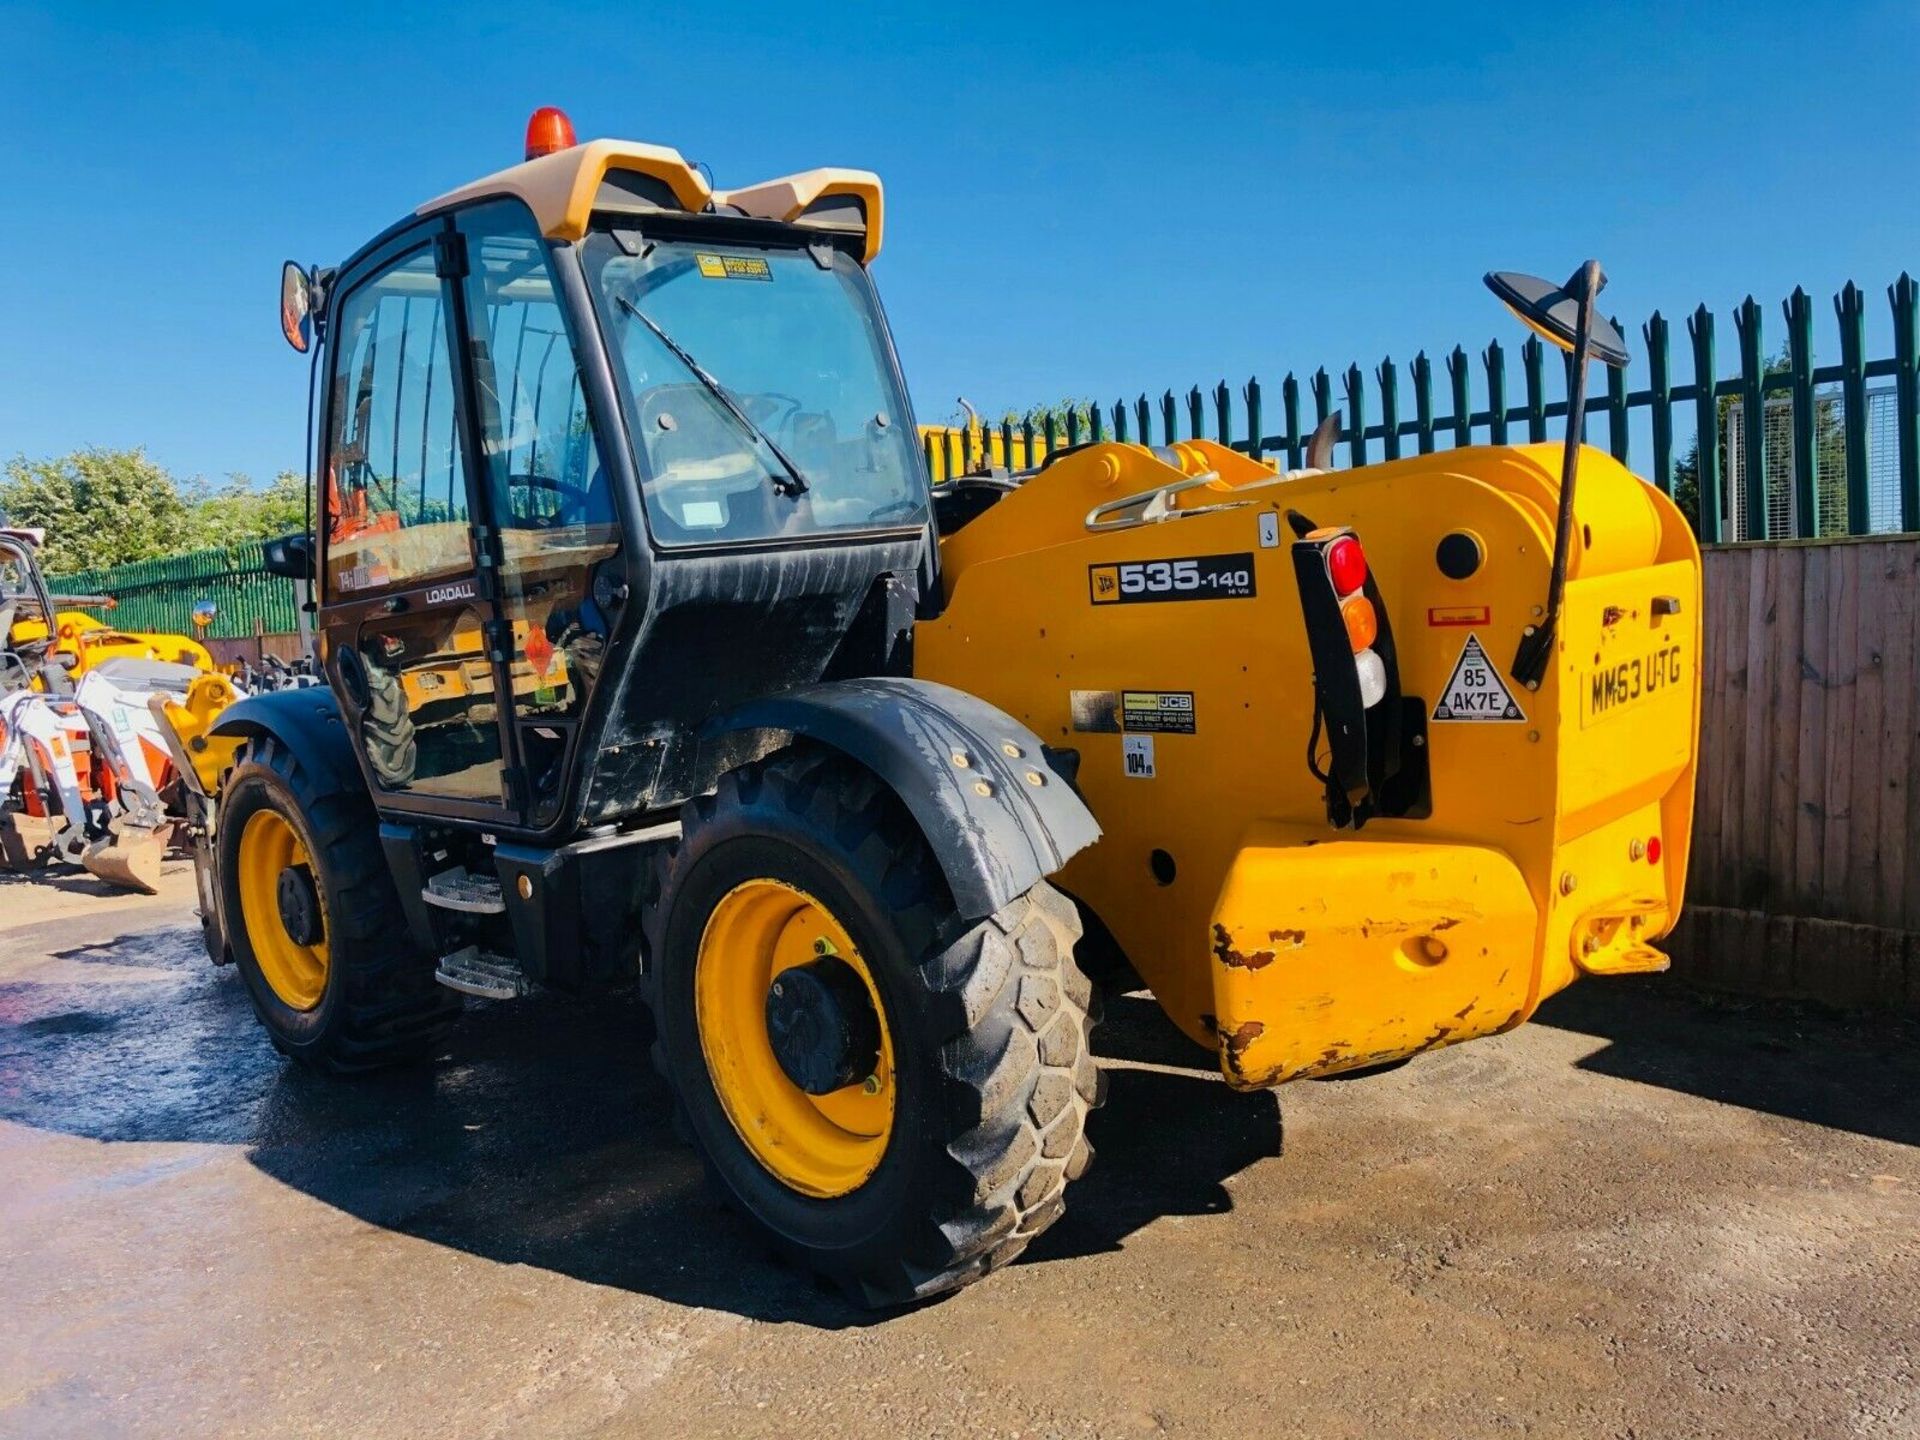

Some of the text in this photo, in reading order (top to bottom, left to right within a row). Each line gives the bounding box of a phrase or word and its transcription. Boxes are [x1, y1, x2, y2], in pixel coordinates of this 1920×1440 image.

[426, 584, 475, 604] LOADALL
[1464, 669, 1486, 687] 85
[1592, 645, 1680, 716] MM63 UTG
[1160, 697, 1189, 708] JCB
[1453, 692, 1501, 711] AK7E
